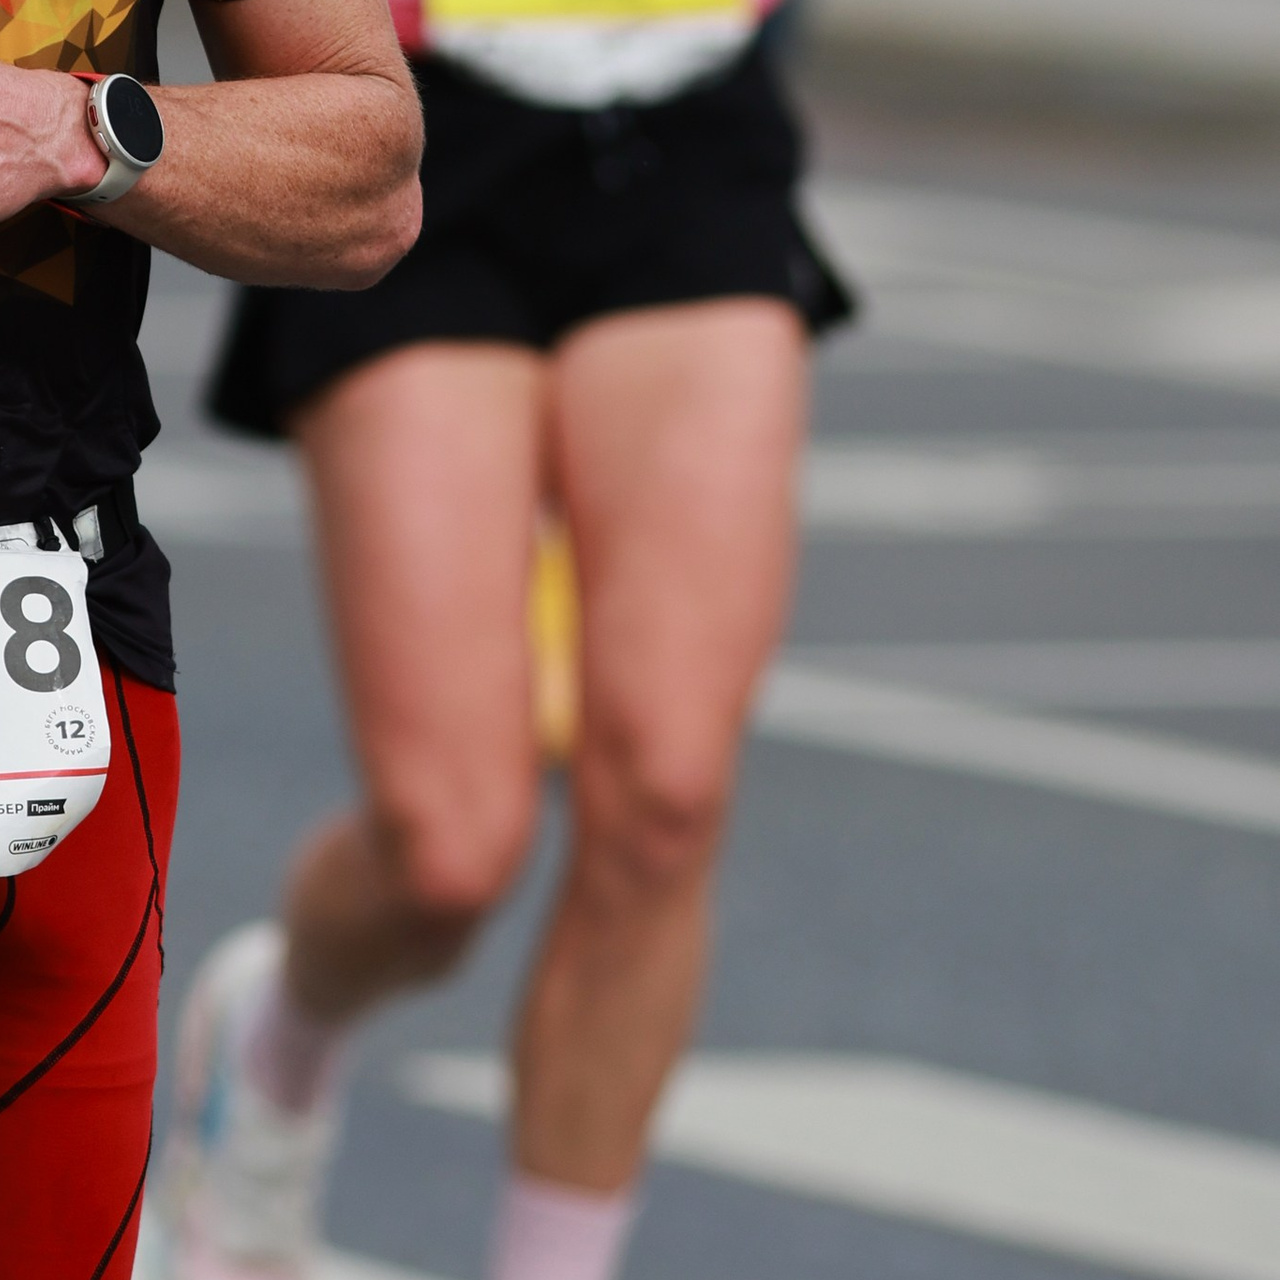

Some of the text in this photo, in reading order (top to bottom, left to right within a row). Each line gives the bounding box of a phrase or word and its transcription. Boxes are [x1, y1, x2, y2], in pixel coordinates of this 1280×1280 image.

[55, 719, 86, 739] 12
[30, 802, 60, 813] Прайм
[12, 839, 49, 852] WINLINE
